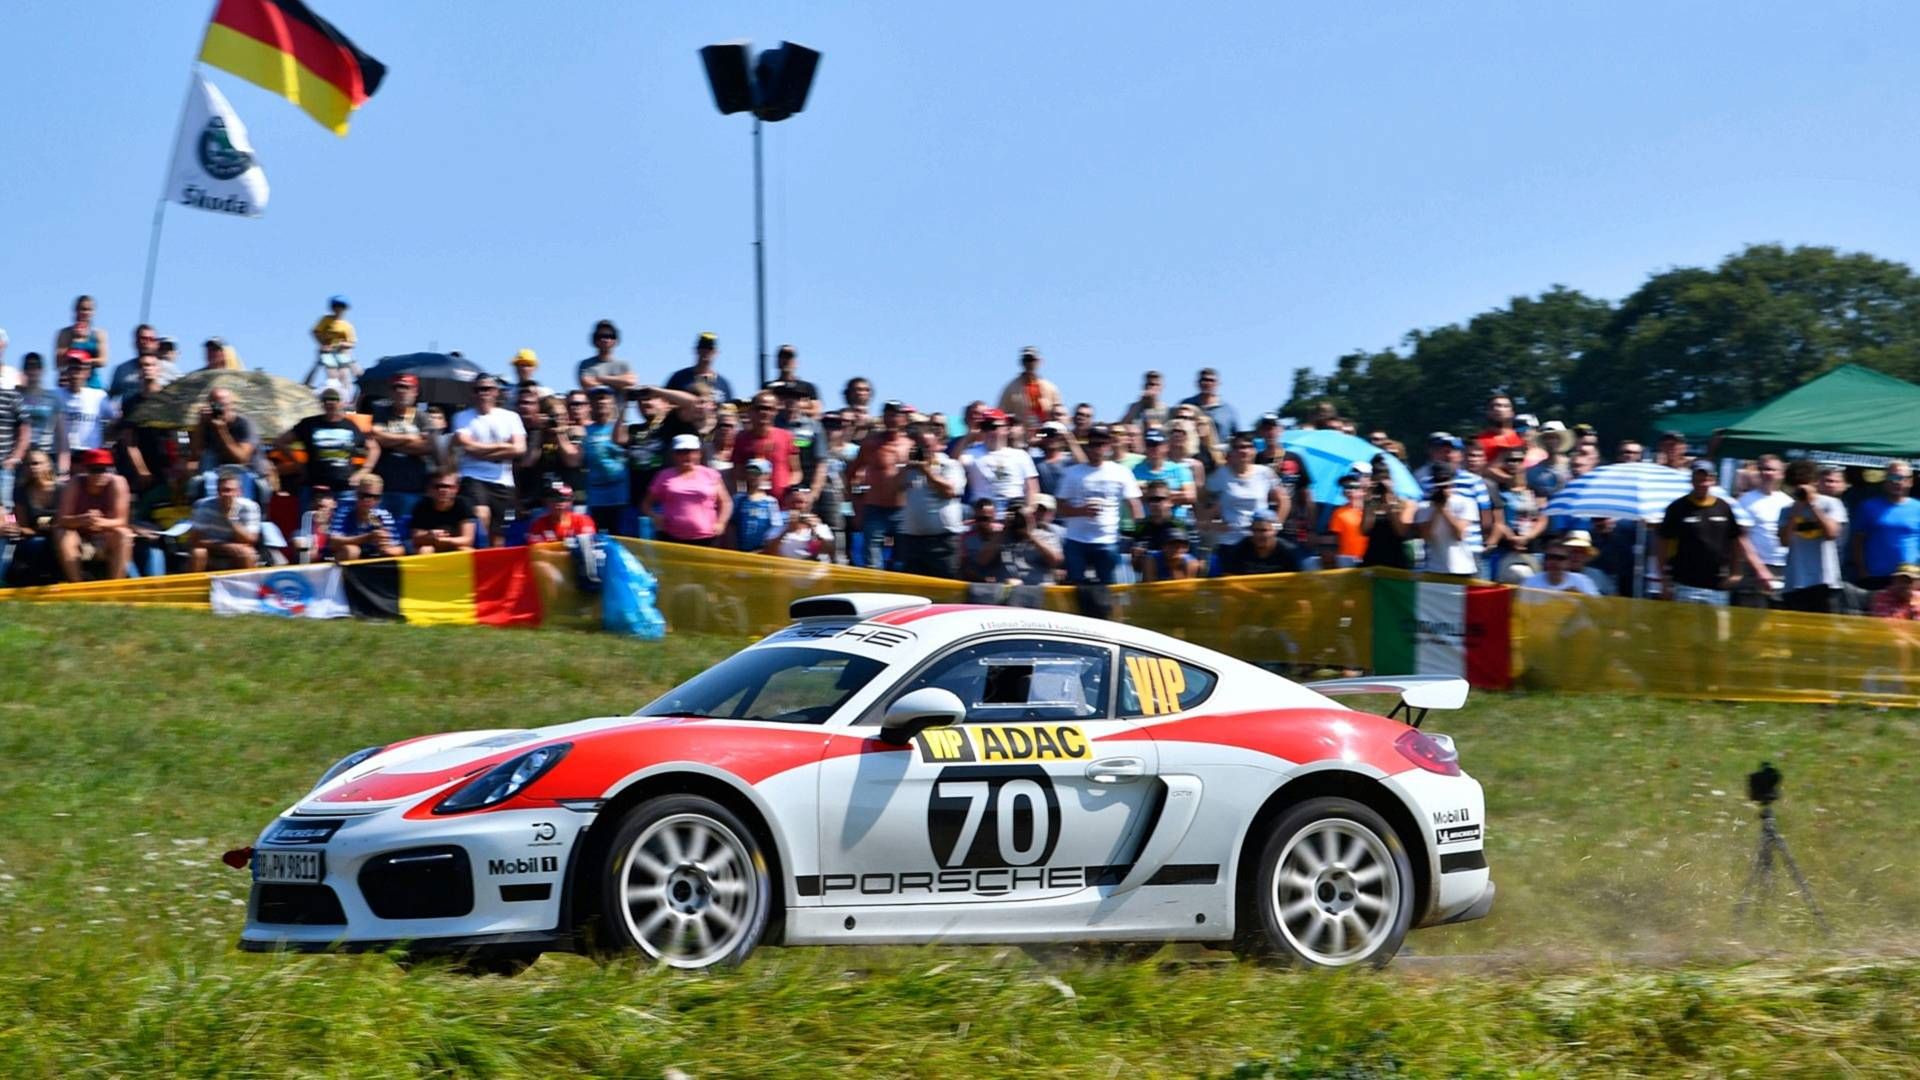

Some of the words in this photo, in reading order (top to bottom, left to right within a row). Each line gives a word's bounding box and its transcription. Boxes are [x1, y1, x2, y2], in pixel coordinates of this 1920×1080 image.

[1125, 655, 1186, 716] VIP
[922, 729, 964, 759] VIP
[980, 726, 1086, 760] ADAC
[938, 778, 1050, 867] 70
[1432, 810, 1460, 825] Mobil
[288, 854, 317, 879] 9811
[488, 857, 539, 875] Mobil
[542, 857, 558, 871] 1
[822, 866, 1085, 896] PORSCHE
